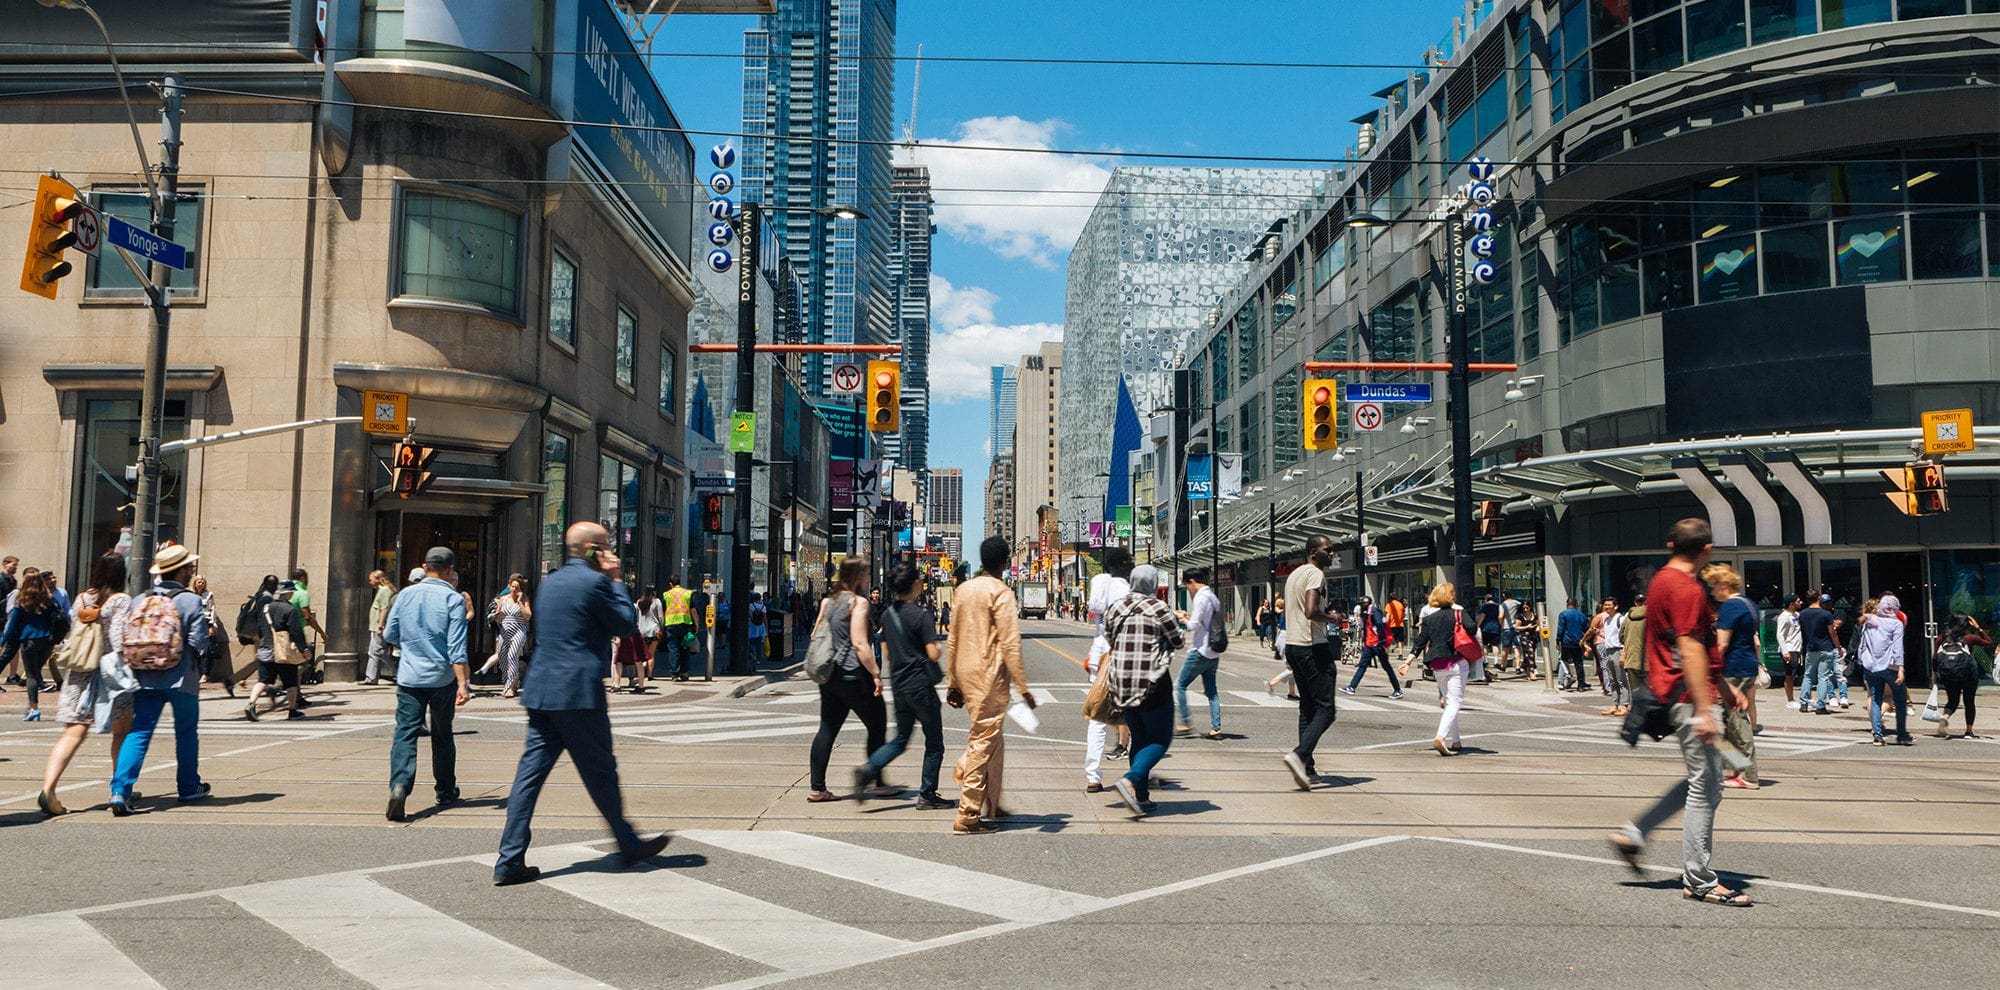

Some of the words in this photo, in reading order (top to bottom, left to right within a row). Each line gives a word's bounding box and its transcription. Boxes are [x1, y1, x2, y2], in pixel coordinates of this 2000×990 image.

[584, 15, 608, 88] LIKE
[609, 54, 619, 105] IT.
[622, 71, 647, 143] WEAR
[647, 111, 655, 156] IT.
[708, 144, 735, 273] Yonge
[1470, 156, 1497, 285] Yonge
[127, 226, 159, 256] Yonge
[160, 241, 167, 251] St
[741, 210, 753, 301] DOWNTOWN
[1453, 222, 1466, 312] DOWNTOWN
[371, 392, 400, 401] PRIORITY
[1361, 386, 1406, 397] Dundas
[369, 422, 400, 431] CROSSING
[1931, 413, 1961, 421] PRIORITY
[1932, 441, 1966, 450] CROSSING
